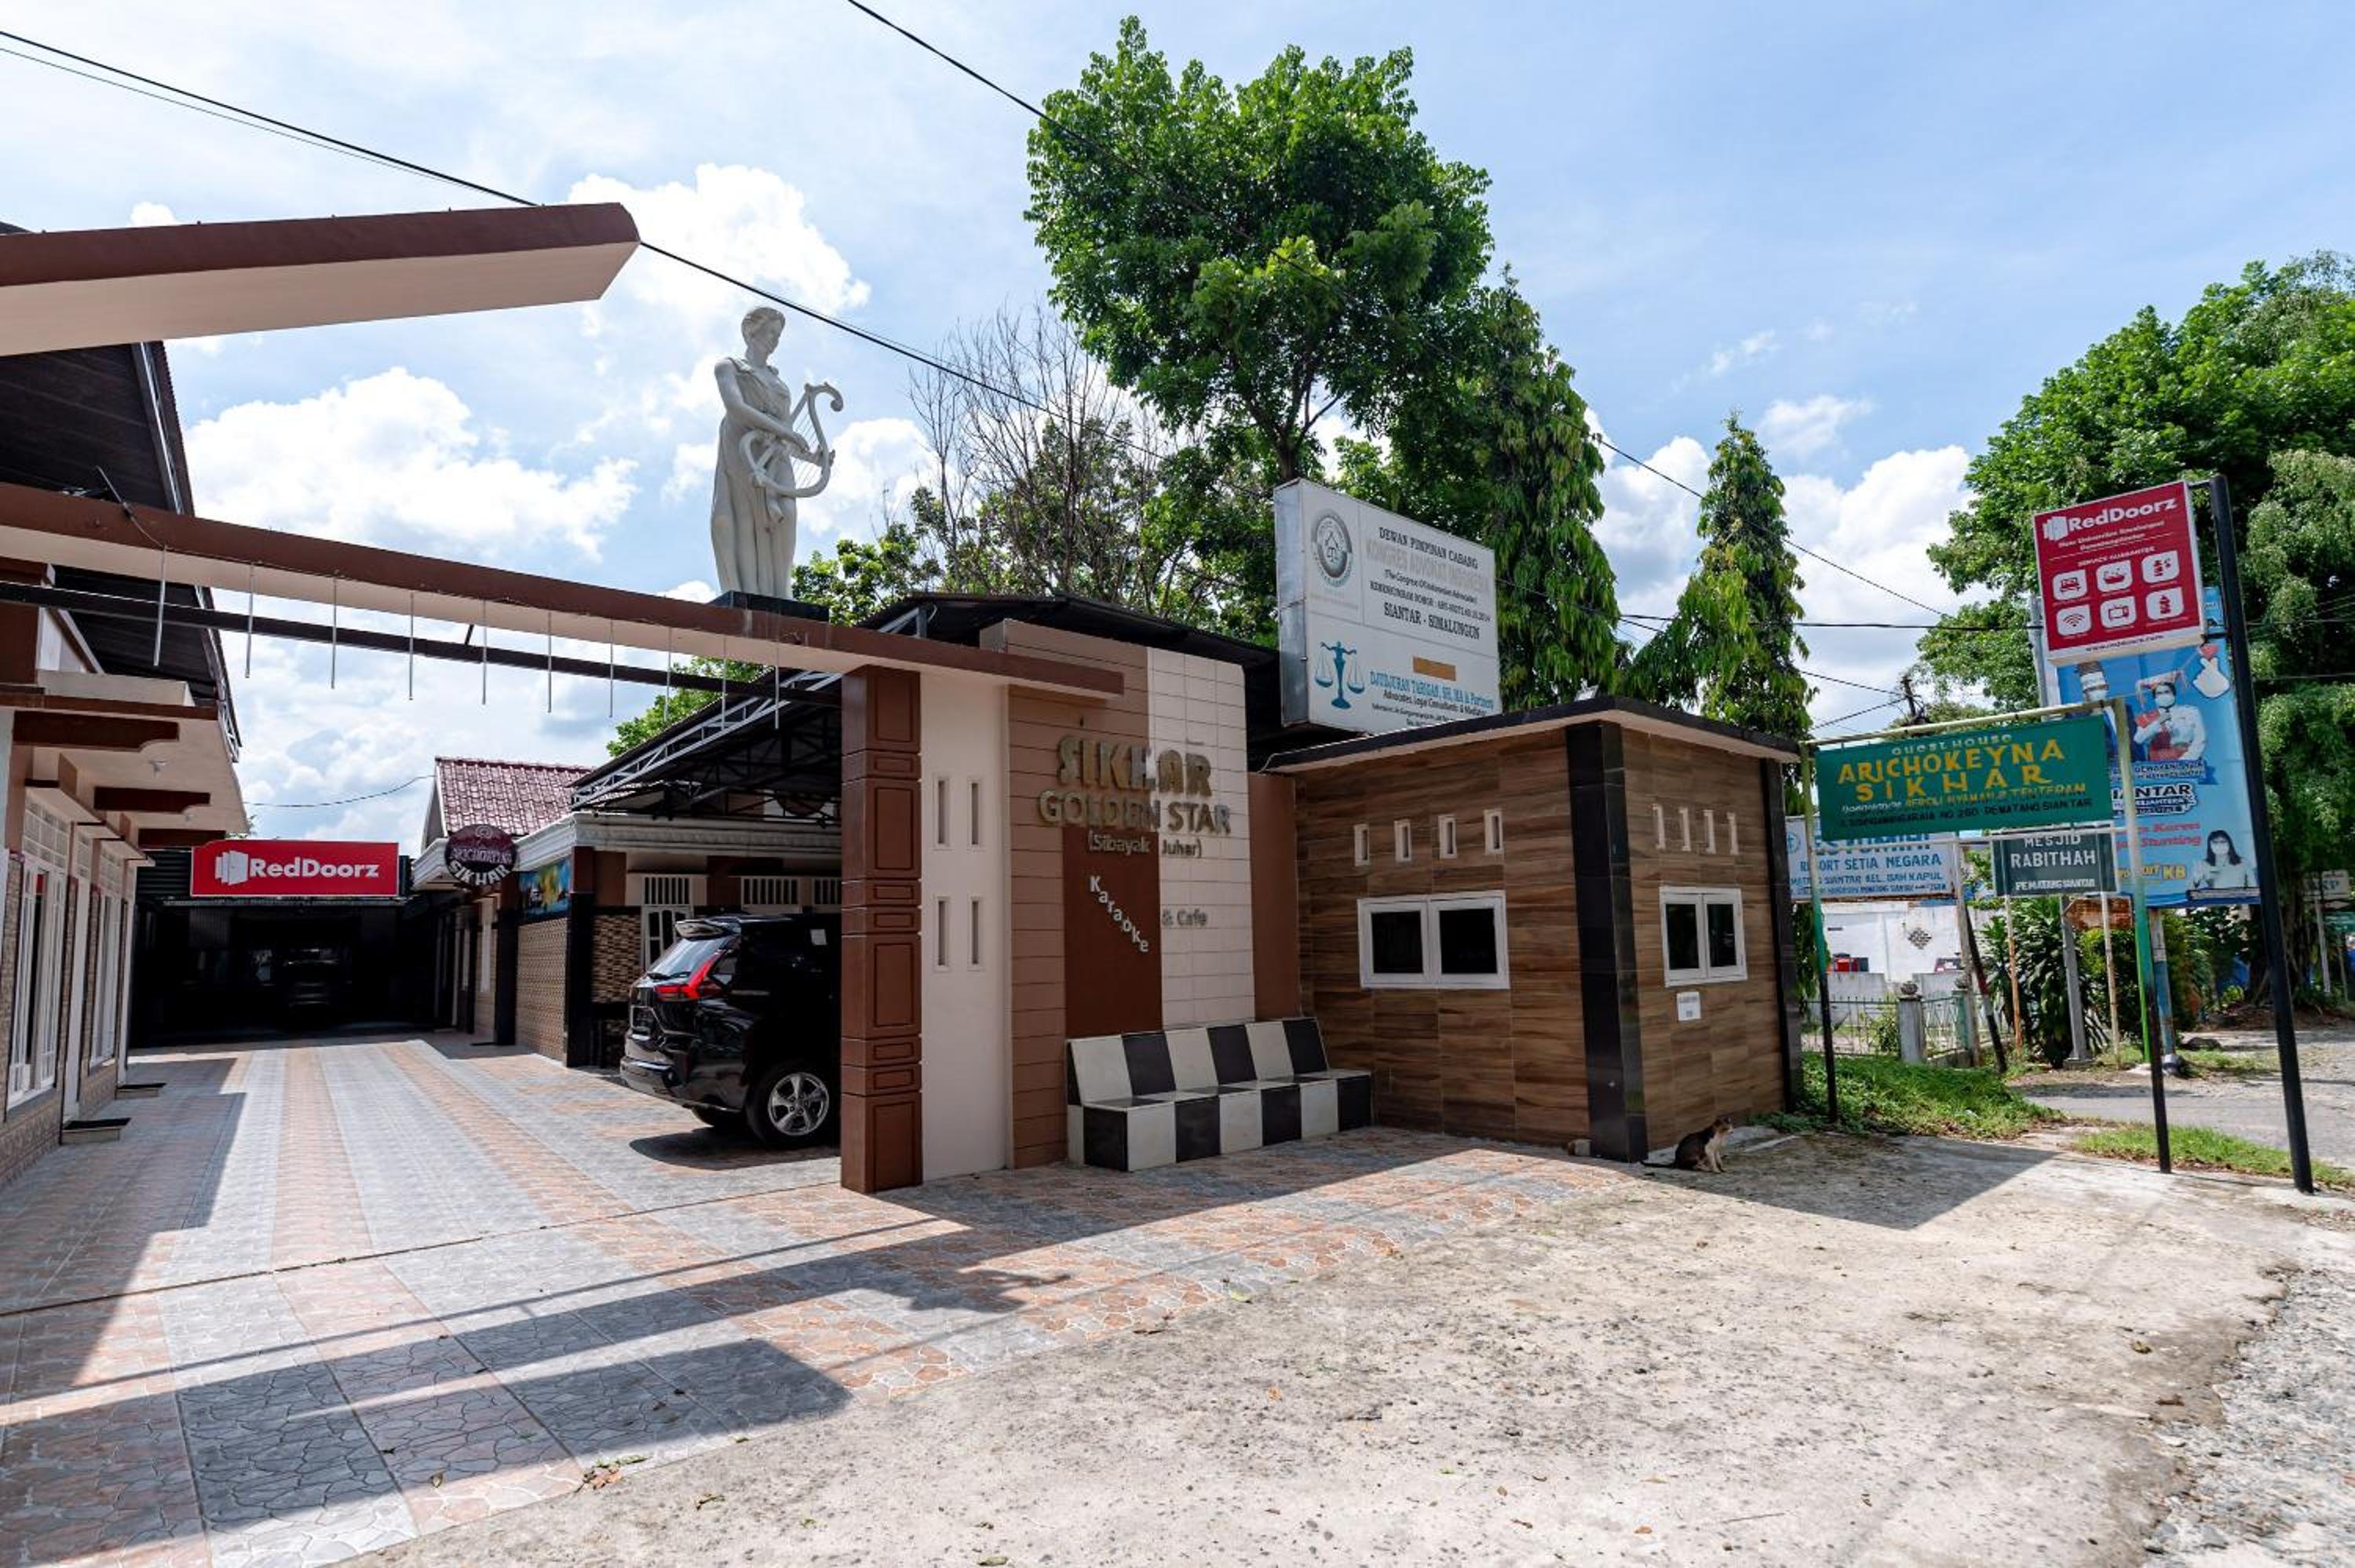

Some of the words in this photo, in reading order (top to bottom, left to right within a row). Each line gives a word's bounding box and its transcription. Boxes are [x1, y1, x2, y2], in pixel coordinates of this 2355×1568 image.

[2068, 498, 2177, 531] RedDoorz
[1379, 527, 1407, 545] DEWAN
[1448, 551, 1478, 569] CABANG
[1384, 602, 1421, 625] SIANTAR
[1838, 738, 2065, 783] ARICHOKEYNA
[1856, 764, 2053, 802] SIKHAR
[1038, 789, 1161, 833] GOLDEN
[1167, 801, 1232, 834] STAR
[2025, 833, 2081, 848] MESJID
[250, 857, 379, 879] RedDoorz
[1845, 858, 1879, 871] SETIA
[1886, 853, 1942, 869] NEGARA
[2010, 850, 2096, 868] RABITHAH
[447, 859, 511, 886] SIKHAR
[2163, 866, 2186, 880] KB
[1089, 875, 1149, 953] Karaoke
[1162, 908, 1174, 926] &
[1177, 908, 1208, 926] Cafe
